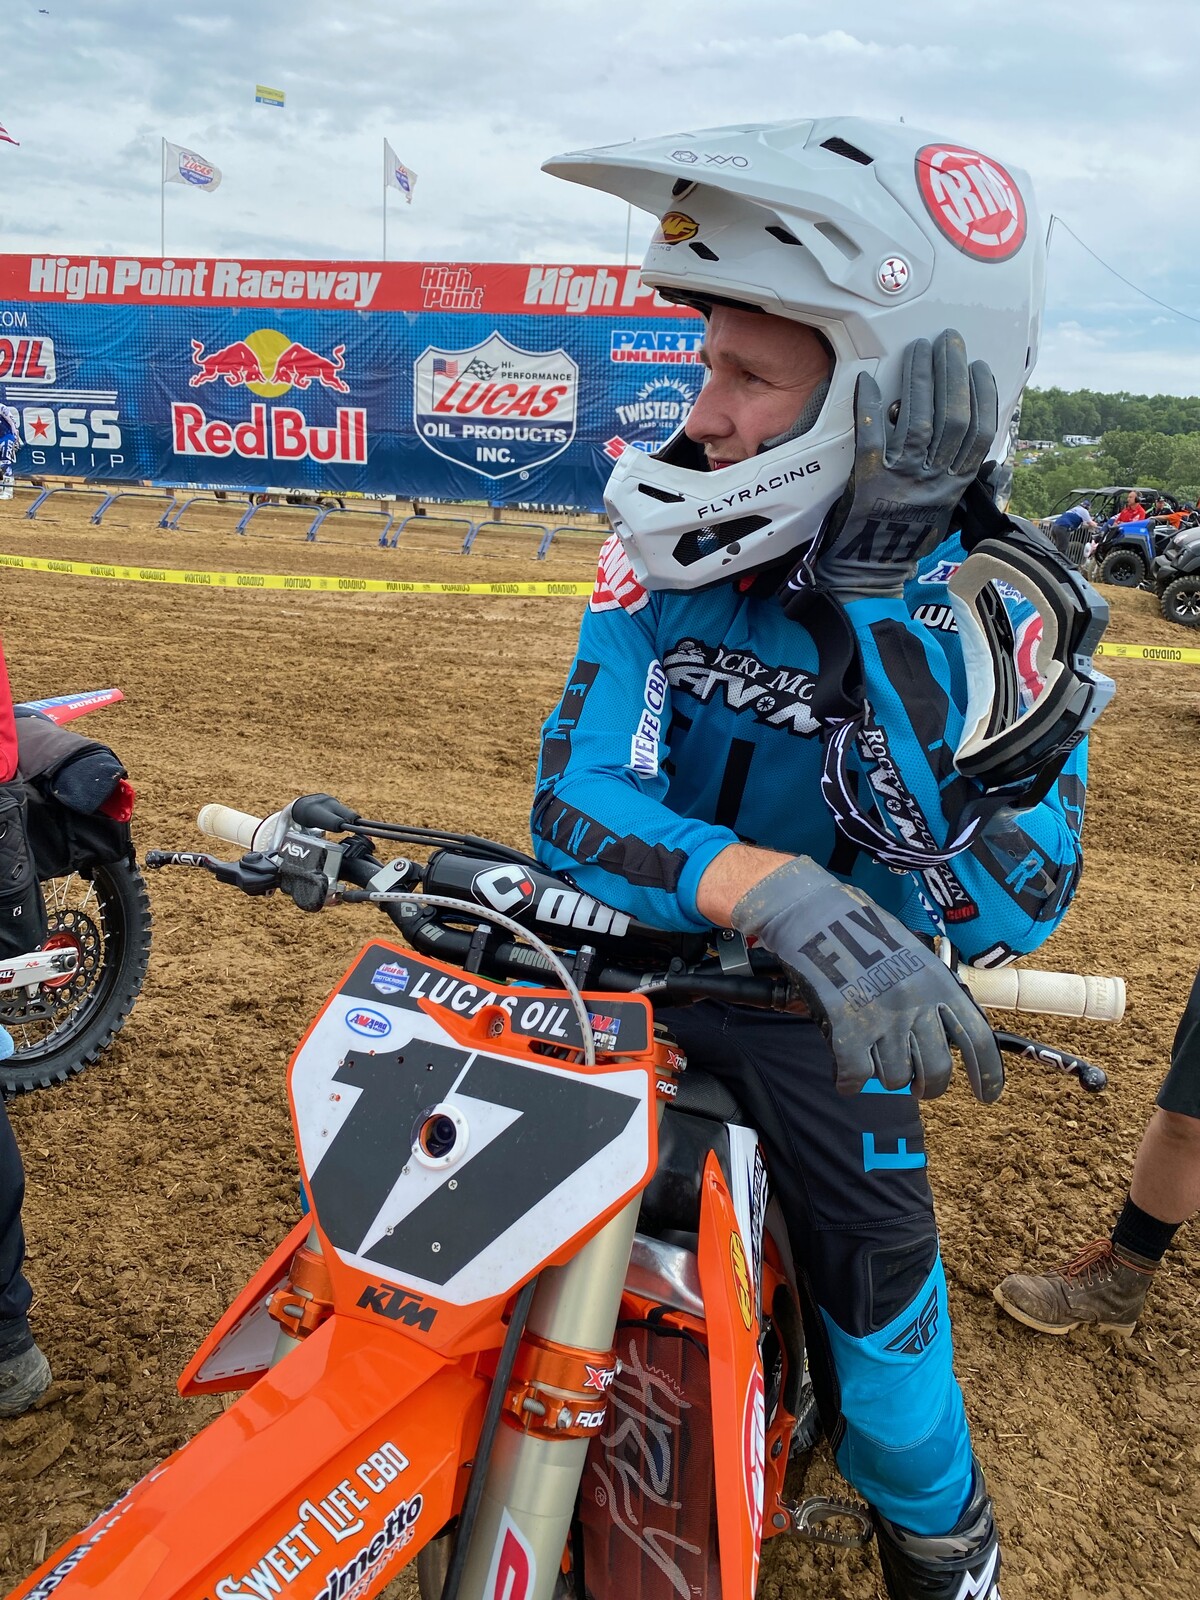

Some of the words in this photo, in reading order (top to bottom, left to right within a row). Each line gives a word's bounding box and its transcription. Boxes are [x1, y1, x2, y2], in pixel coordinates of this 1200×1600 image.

[29, 257, 108, 300] High
[112, 260, 208, 297] Point
[211, 262, 382, 307] Raceway
[421, 266, 472, 291] High
[523, 266, 619, 313] High
[423, 287, 485, 310] Point
[612, 331, 705, 350] PART
[612, 350, 705, 364] UNLIMIT
[501, 371, 572, 382] PERFORMANCE
[432, 381, 568, 417] LUCAS
[615, 401, 680, 426] TWISTED
[171, 402, 268, 460] Red
[271, 406, 367, 464] Bull
[423, 422, 456, 438] OIL
[462, 425, 567, 443] PRODUCTS
[476, 447, 516, 464] INC.
[1142, 648, 1181, 661] CUIDADO
[67, 694, 113, 710] DUNLOP
[282, 842, 311, 860] ASV
[798, 905, 904, 989] FLY
[840, 949, 926, 1013] RACING
[409, 971, 519, 1021] LUCAS
[521, 1000, 569, 1038] OIL
[1020, 1045, 1079, 1074] ASV
[309, 1038, 642, 1286] 17
[356, 1283, 438, 1332] KTM
[215, 1522, 322, 1600] SWEET
[298, 1478, 370, 1544] LIFE
[355, 1440, 410, 1494] CBD
